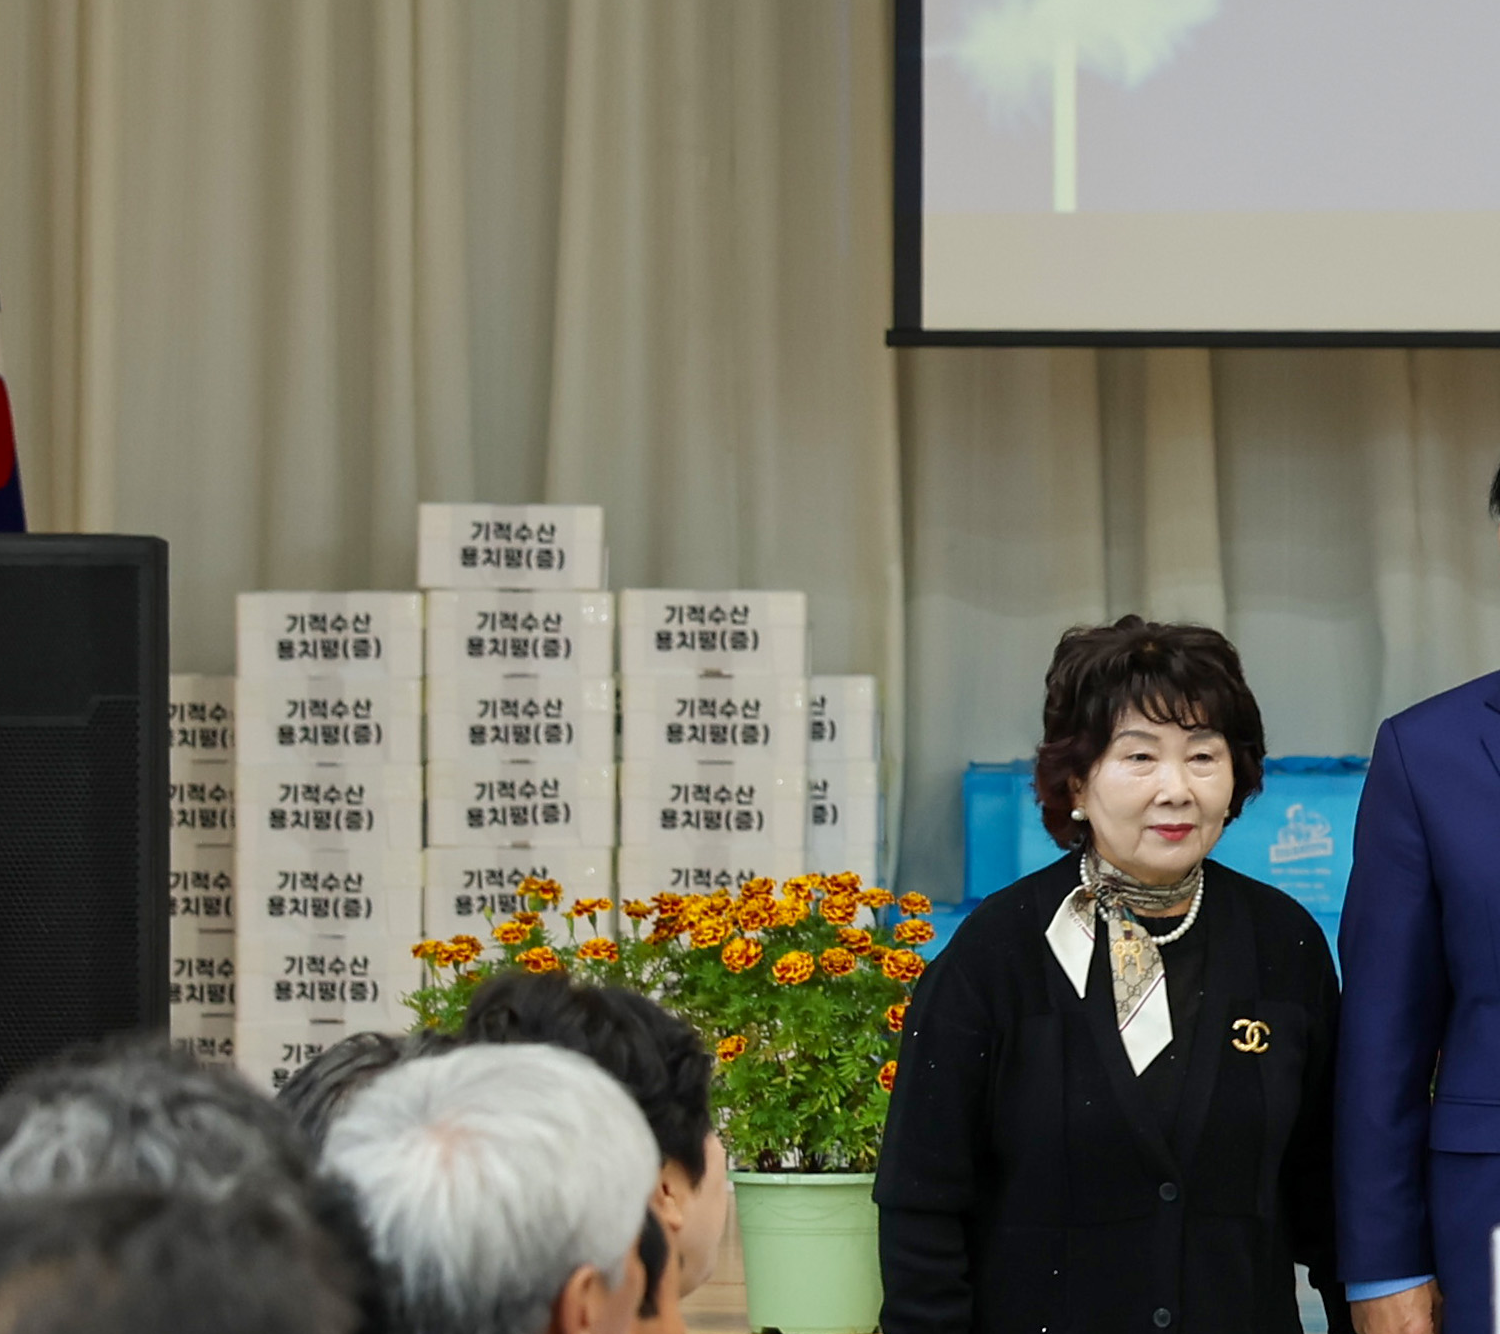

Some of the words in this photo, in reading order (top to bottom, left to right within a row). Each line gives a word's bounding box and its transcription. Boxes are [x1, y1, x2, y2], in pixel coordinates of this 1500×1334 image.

[471, 521, 556, 543] 기적수산
[287, 612, 372, 635] 기적수산
[477, 611, 562, 633] 기적수산
[665, 603, 750, 626] 기적수산
[288, 698, 373, 720] 기적수산
[479, 697, 564, 720] 기적수산
[676, 697, 761, 719] 기적수산
[280, 783, 365, 805] 기적수산
[475, 779, 561, 804] 기적수산
[670, 783, 755, 805] 기적수산
[278, 871, 363, 893] 기적수산
[285, 954, 370, 977] 기적수산
